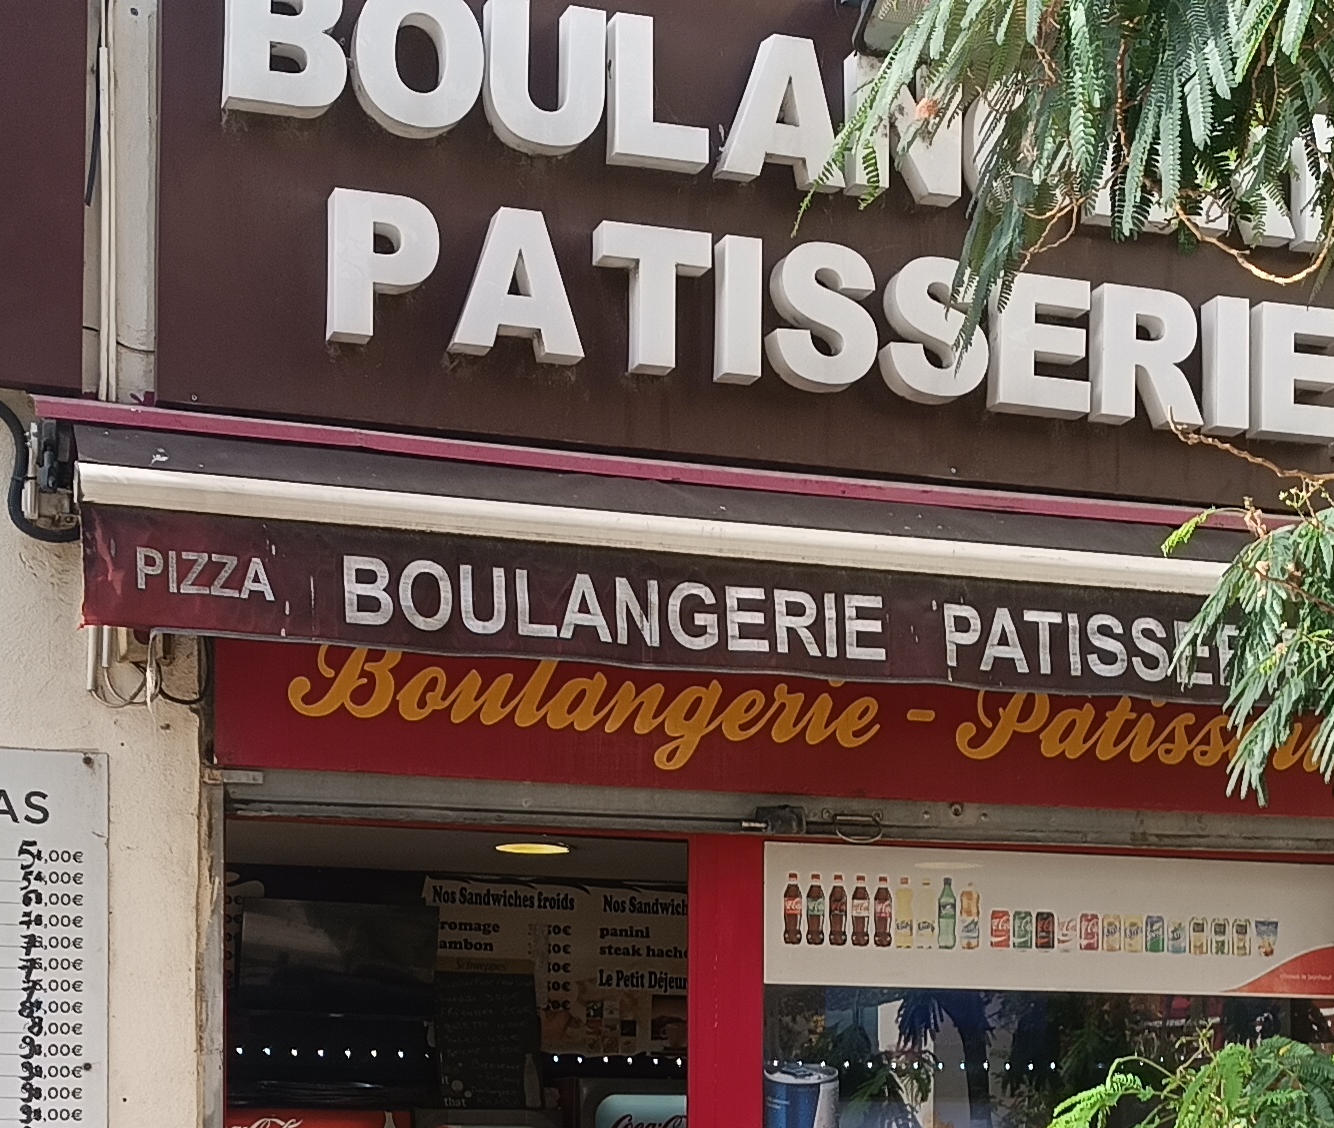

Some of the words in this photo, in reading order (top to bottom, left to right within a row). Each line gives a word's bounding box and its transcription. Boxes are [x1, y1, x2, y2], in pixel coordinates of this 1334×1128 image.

[135, 546, 276, 602] PIZZA
[342, 554, 886, 661] BOULANGERIE
[943, 603, 1299, 688] PATISSE
[287, 643, 880, 770] Boulangerie
[432, 885, 456, 904] Nos
[459, 887, 535, 909] Sandwiches
[537, 891, 575, 911] froids
[603, 895, 626, 913] Nos
[629, 896, 687, 916] Sandwich
[440, 921, 500, 935] romage
[599, 926, 651, 939] panini
[438, 939, 494, 952] ambon
[599, 945, 642, 957] steak
[598, 969, 613, 987] Le
[615, 970, 645, 988] Petit
[648, 971, 687, 993] Déjeu
